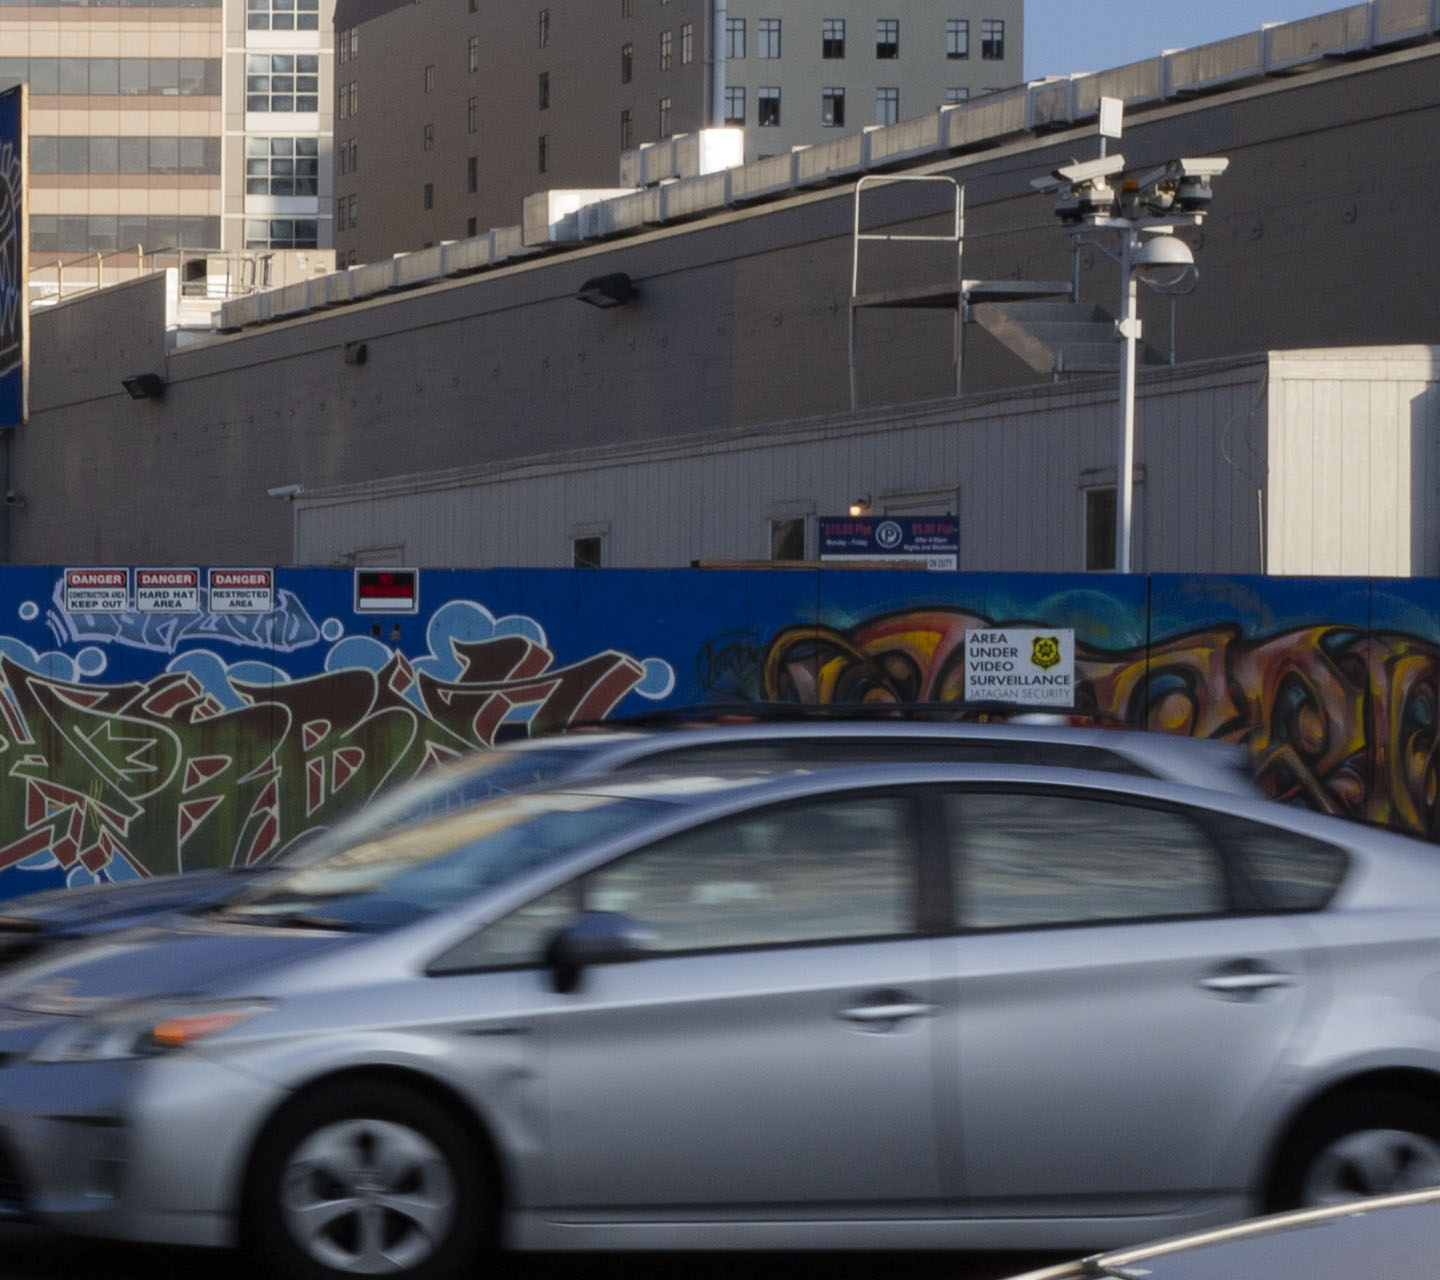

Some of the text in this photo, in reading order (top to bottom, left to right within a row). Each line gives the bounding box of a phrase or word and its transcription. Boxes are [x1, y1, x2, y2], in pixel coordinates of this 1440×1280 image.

[71, 574, 122, 585] DANGER
[142, 574, 192, 585] DANGER
[215, 574, 266, 585] DANGER
[69, 591, 125, 599] CONSTRUCTION AREA
[139, 591, 195, 599] HARD HAT
[213, 591, 269, 599] RESTRICTED
[71, 600, 122, 609] KEEP OUT
[153, 600, 183, 609] AREA
[229, 600, 254, 608] AREA
[969, 633, 1008, 644] AREA
[969, 647, 1019, 658] UNDER
[969, 661, 1015, 672] VIDEO
[969, 675, 1071, 686] SURVEILLANCE
[1022, 688, 1071, 698] SECURITY
